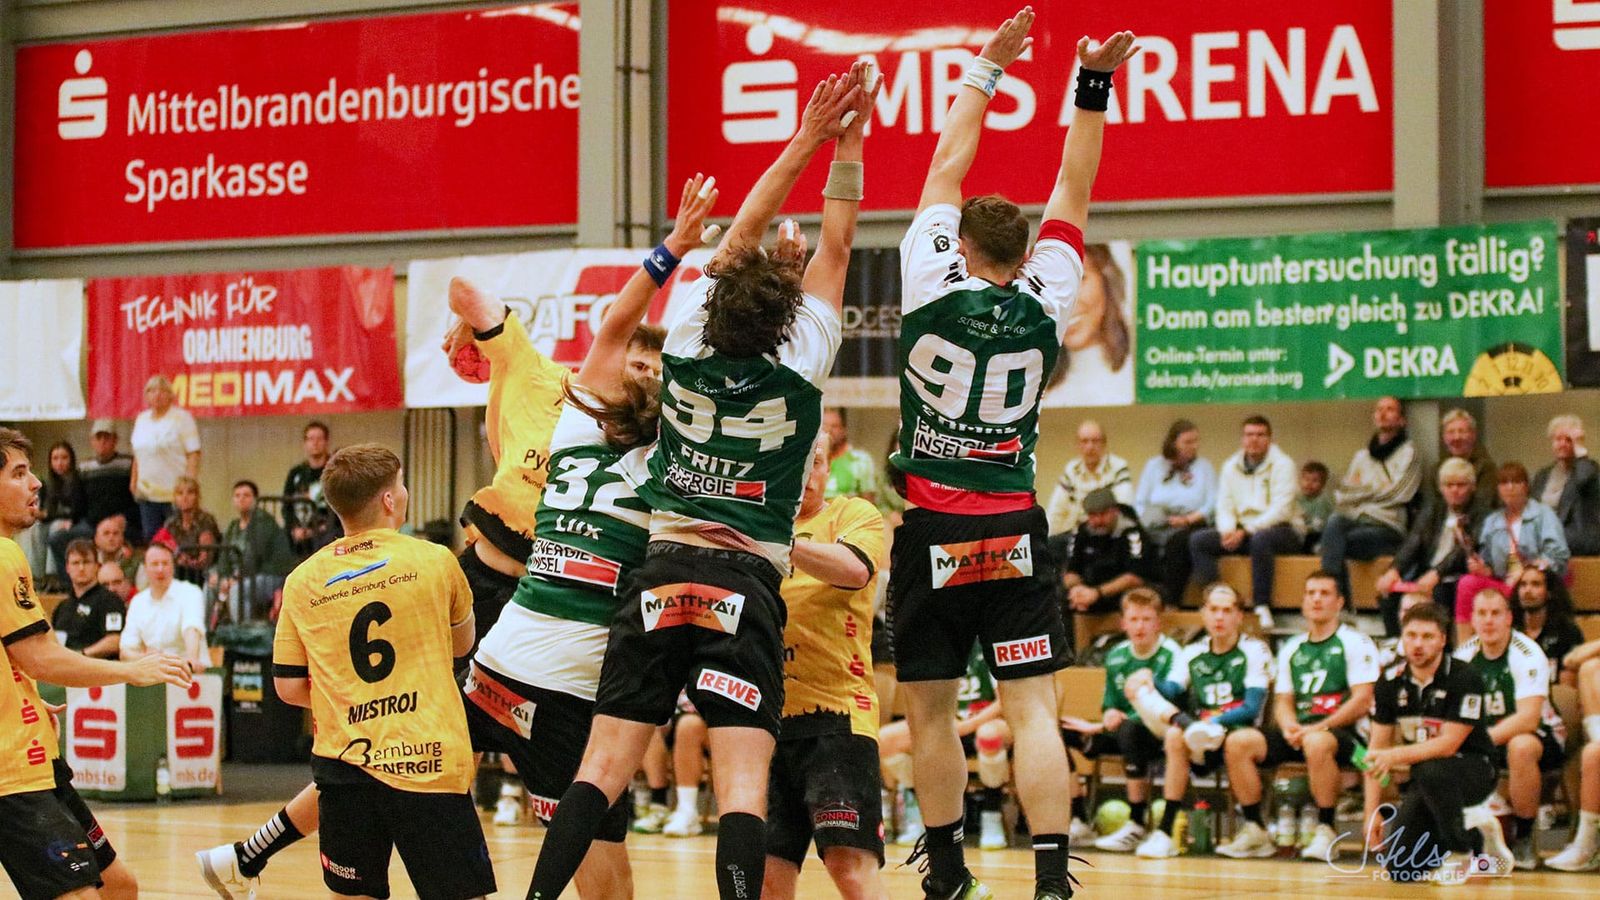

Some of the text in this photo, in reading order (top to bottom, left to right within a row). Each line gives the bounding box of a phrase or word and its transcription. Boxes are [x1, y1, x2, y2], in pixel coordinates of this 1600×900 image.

[125, 62, 580, 137] Mittelbrandenburgische
[123, 153, 309, 213] Sparkasse
[1146, 235, 1545, 296] Hauptuntersuchung fällig?
[120, 277, 278, 334] TECHNIK FÜR
[1146, 304, 1207, 330] Dann
[1213, 309, 1250, 328] am
[1335, 292, 1406, 330] gleich
[1414, 302, 1442, 320] zu
[1448, 287, 1544, 319] DEKRA!
[182, 325, 313, 365] ORANIENBURG
[1146, 345, 1245, 364] Online-Termin
[1364, 344, 1460, 378] DEKRA
[904, 333, 1044, 425] 90
[1146, 367, 1304, 390] dekra.de/oranienburg
[661, 379, 797, 453] 34
[680, 442, 755, 478] FRITZ
[543, 456, 651, 531] 32
[554, 514, 604, 540] LUX
[310, 571, 418, 609] Stadtwerke Bernburg GmbH
[348, 600, 396, 684] 6
[996, 638, 1047, 664] REWE
[347, 691, 418, 725] NIESTROJ
[700, 671, 758, 707] REWE
